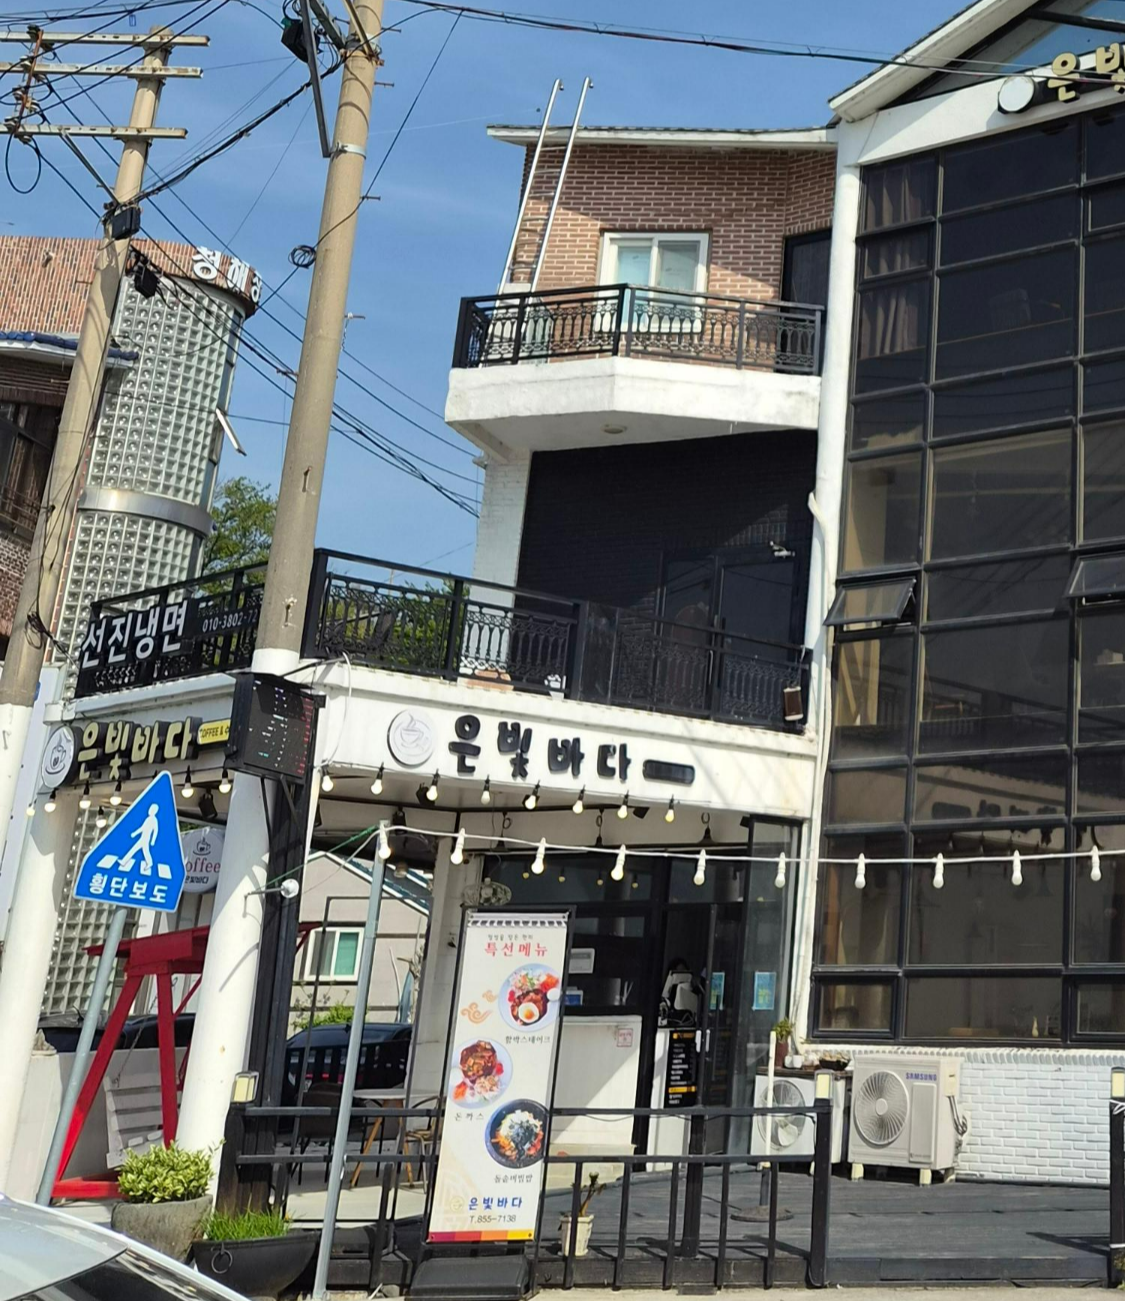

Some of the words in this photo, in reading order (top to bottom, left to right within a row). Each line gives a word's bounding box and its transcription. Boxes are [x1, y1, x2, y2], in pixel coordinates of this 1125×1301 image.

[81, 599, 189, 670] 선진냉면
[202, 608, 258, 633] 010-3802-72
[77, 715, 195, 781] 은빛바다
[448, 714, 631, 783] 은빛바다
[185, 857, 221, 874] offee
[89, 872, 169, 904] 횡단보도
[484, 941, 548, 957] 특선메뉴
[905, 1071, 938, 1082] SAMSUNG
[468, 1196, 523, 1211] 은빛바다
[469, 1214, 517, 1224] T.855-7138
